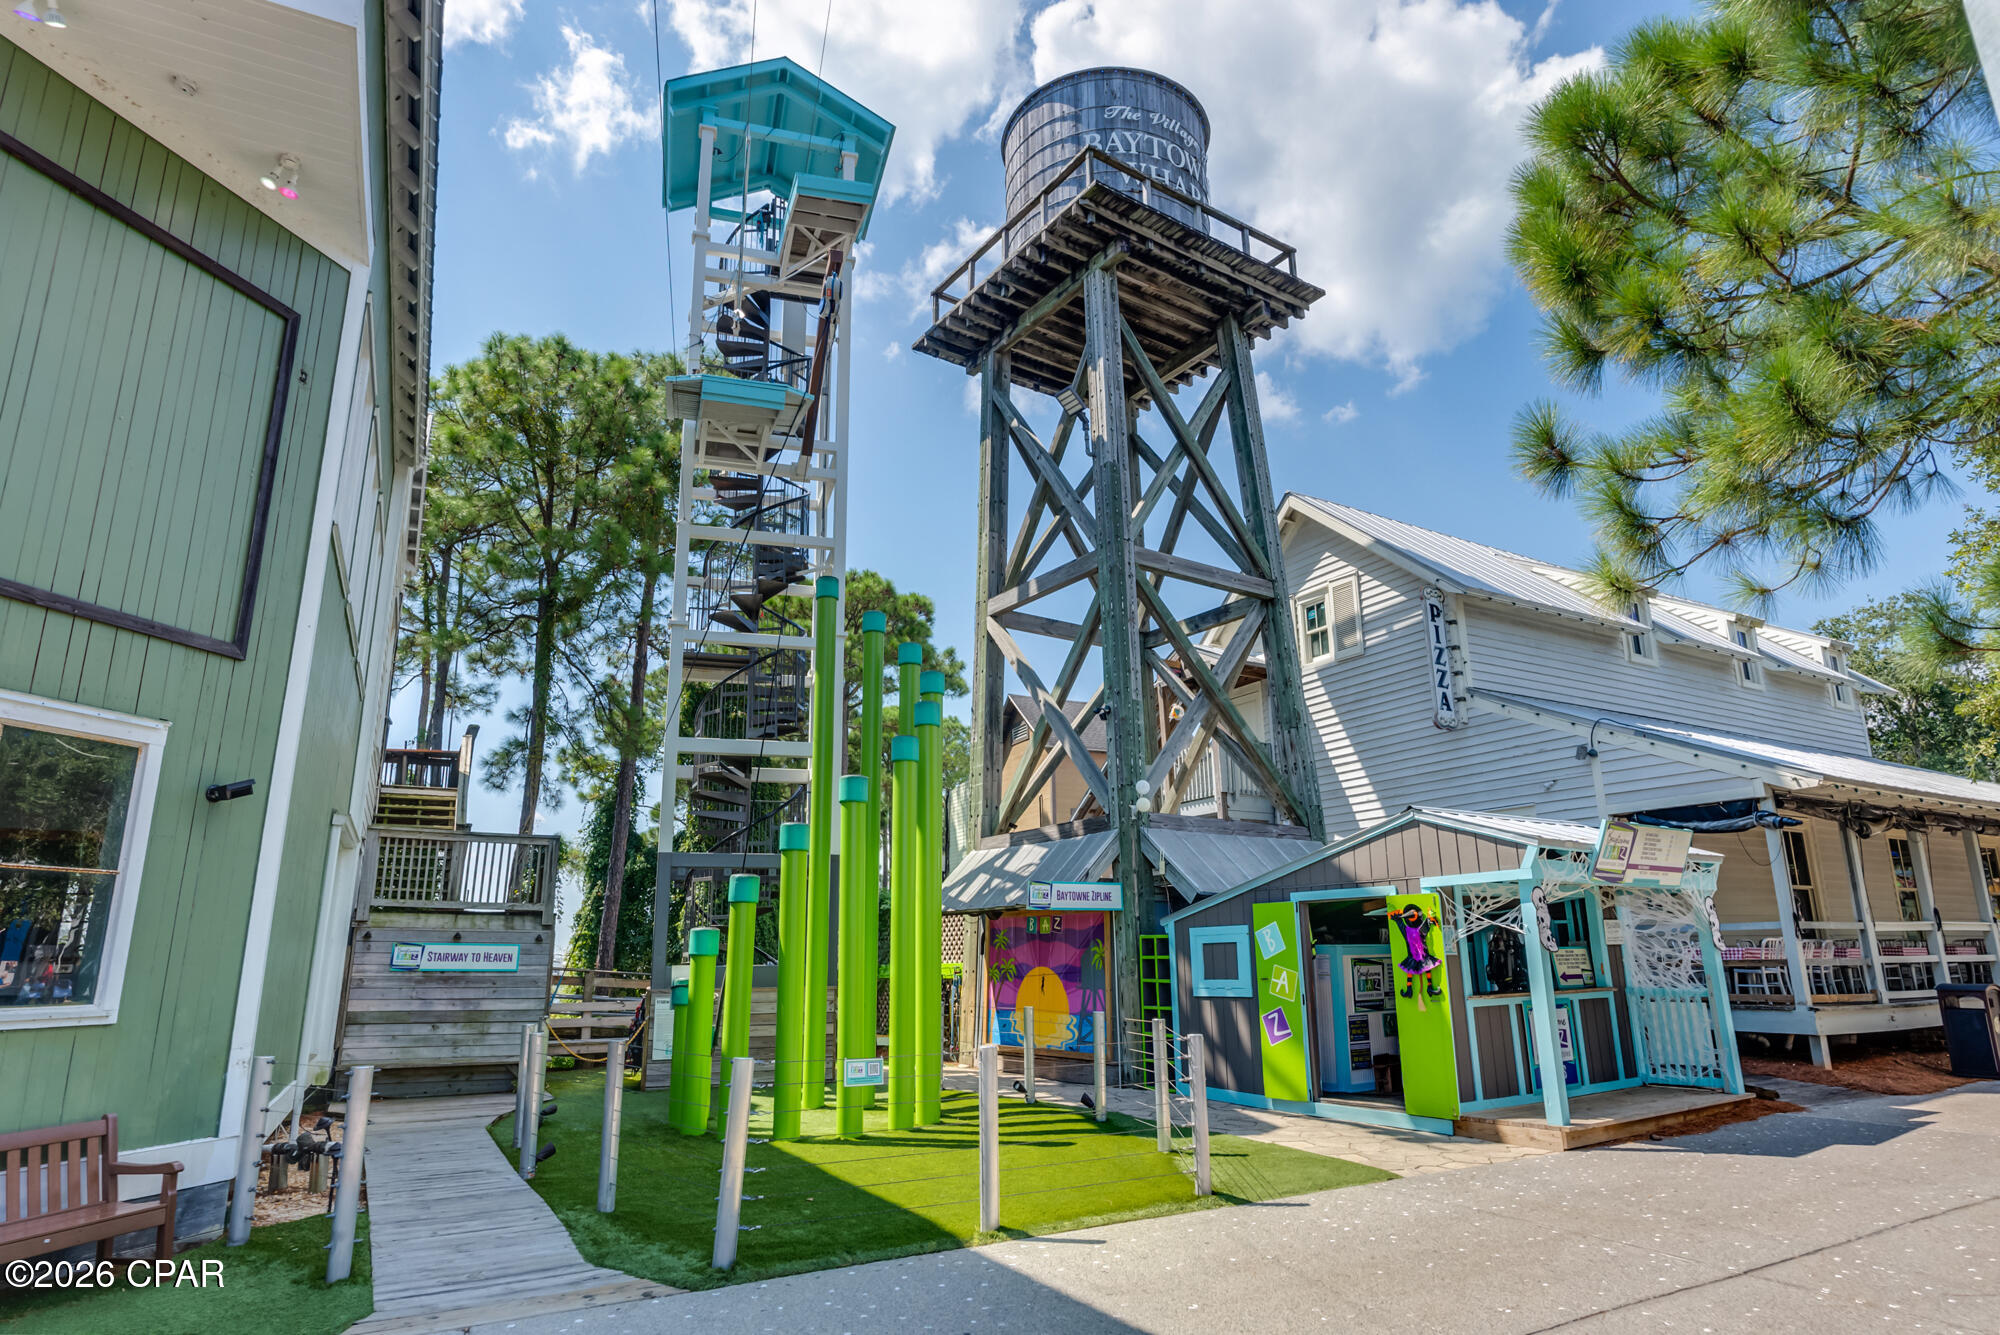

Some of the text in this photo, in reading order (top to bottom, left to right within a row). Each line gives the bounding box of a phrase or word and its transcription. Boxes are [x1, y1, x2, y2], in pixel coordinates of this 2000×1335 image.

[1104, 105, 1142, 121] The
[1428, 603, 1453, 712] PIZZA
[1056, 890, 1090, 902] BAYTOWNE
[1091, 890, 1113, 902] ZIPLINE
[1028, 917, 1062, 932] BAZ
[427, 951, 469, 962] STAIRWAY
[471, 952, 481, 963] TO
[483, 951, 513, 963] HEAVEN
